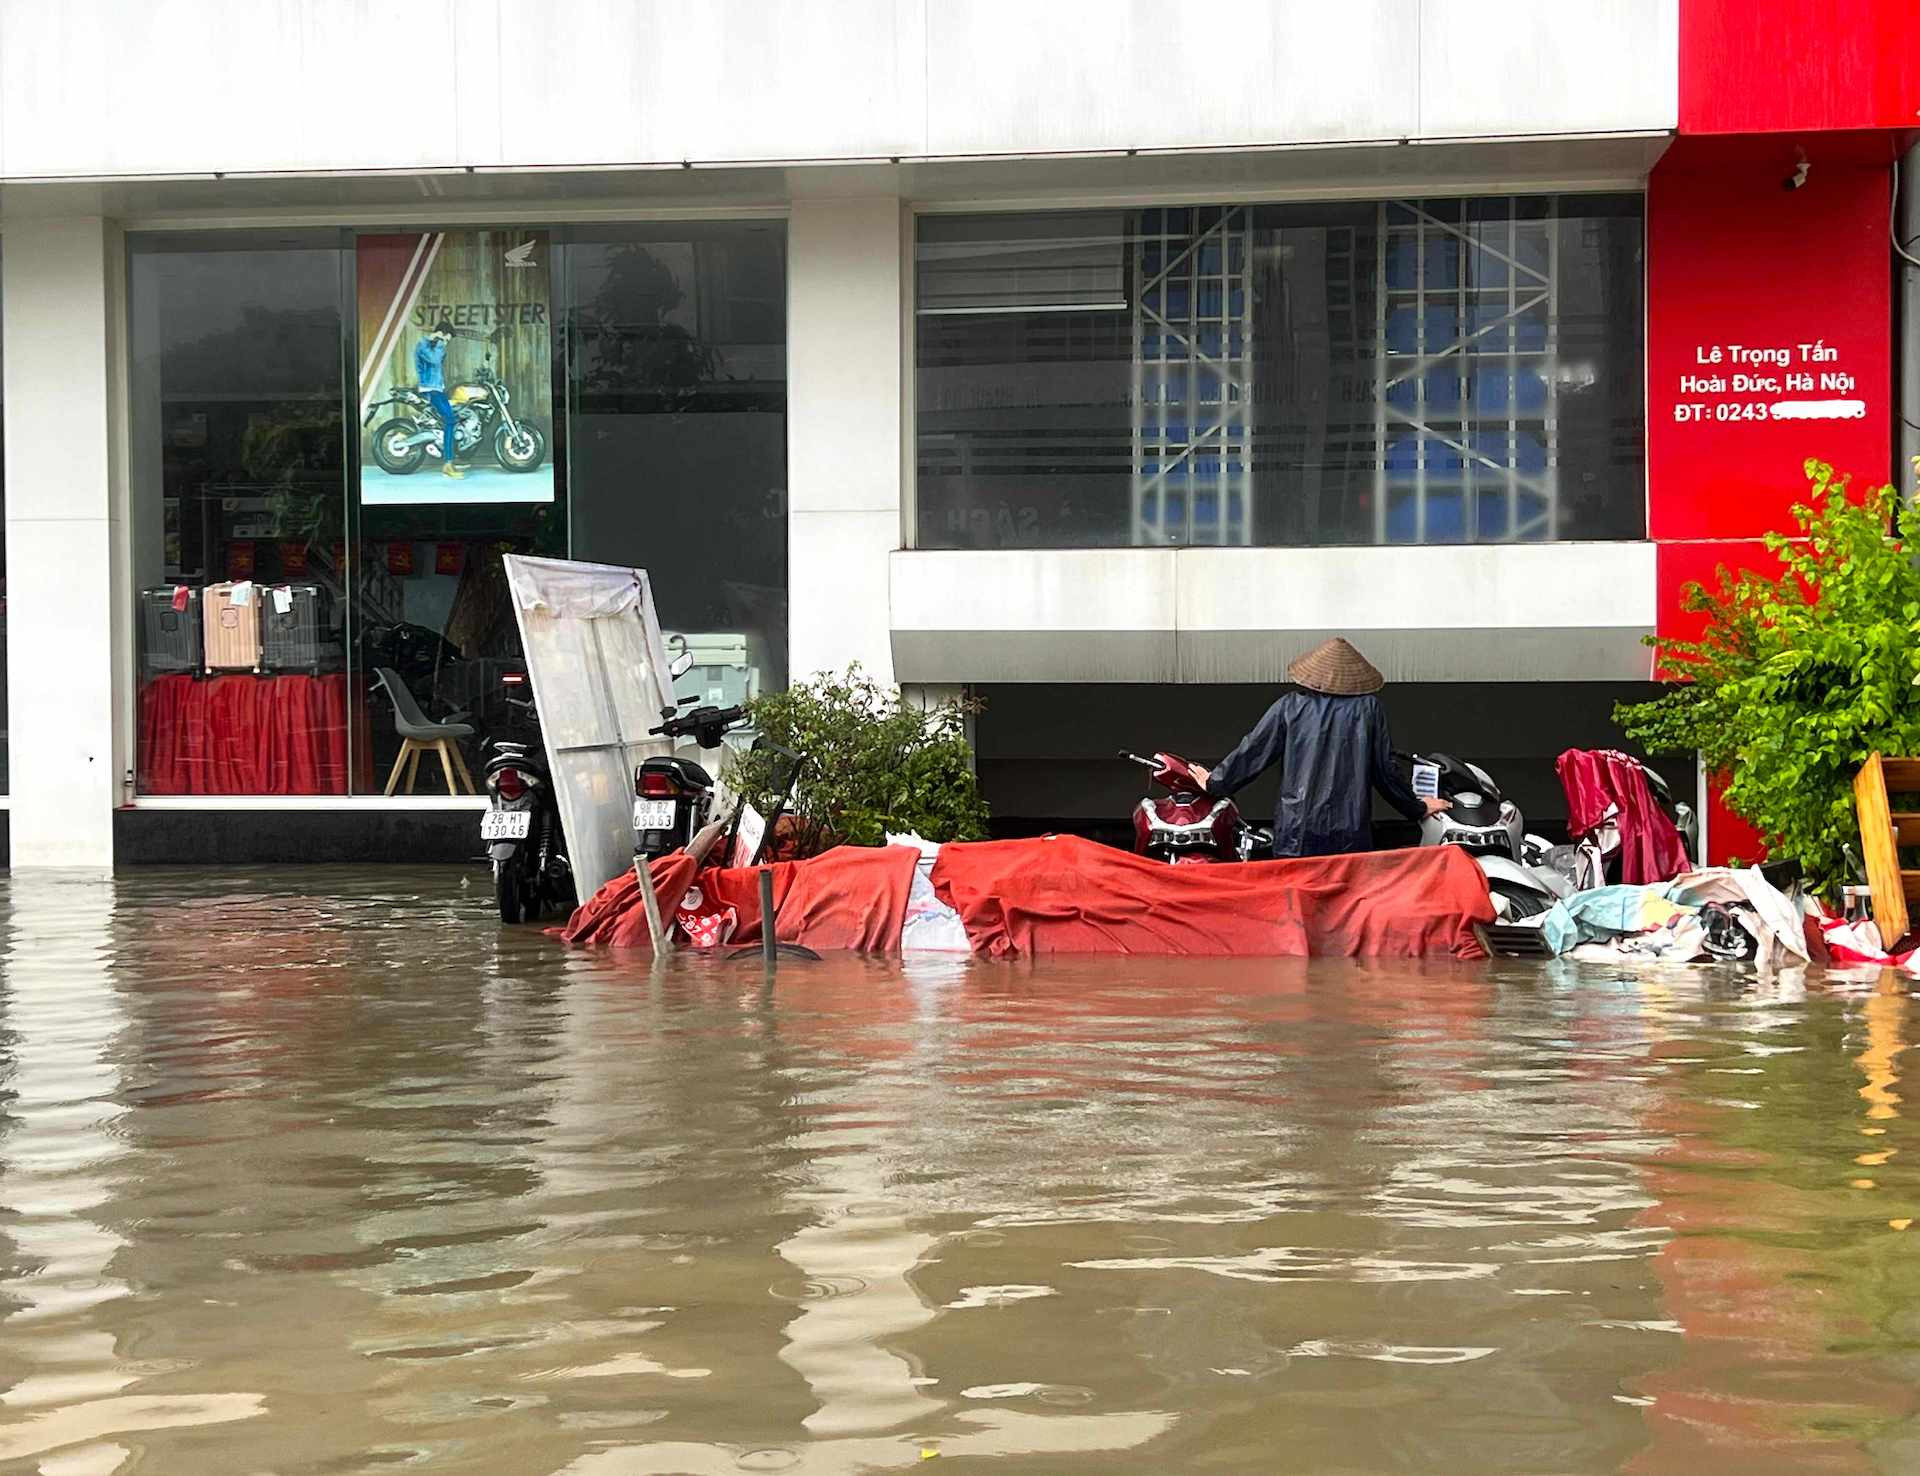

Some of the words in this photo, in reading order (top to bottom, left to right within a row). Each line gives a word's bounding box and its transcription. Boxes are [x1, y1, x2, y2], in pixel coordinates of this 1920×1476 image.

[1697, 346, 1722, 364] Lê
[1728, 345, 1790, 367] Trọng
[1797, 340, 1837, 362] Tấn
[1680, 374, 1726, 393] Hoài
[1732, 373, 1782, 394] Đức,
[1786, 372, 1814, 391] Hà
[1820, 372, 1855, 395] Nội
[1674, 404, 1712, 422] ĐT:
[1715, 403, 1768, 421] 0243
